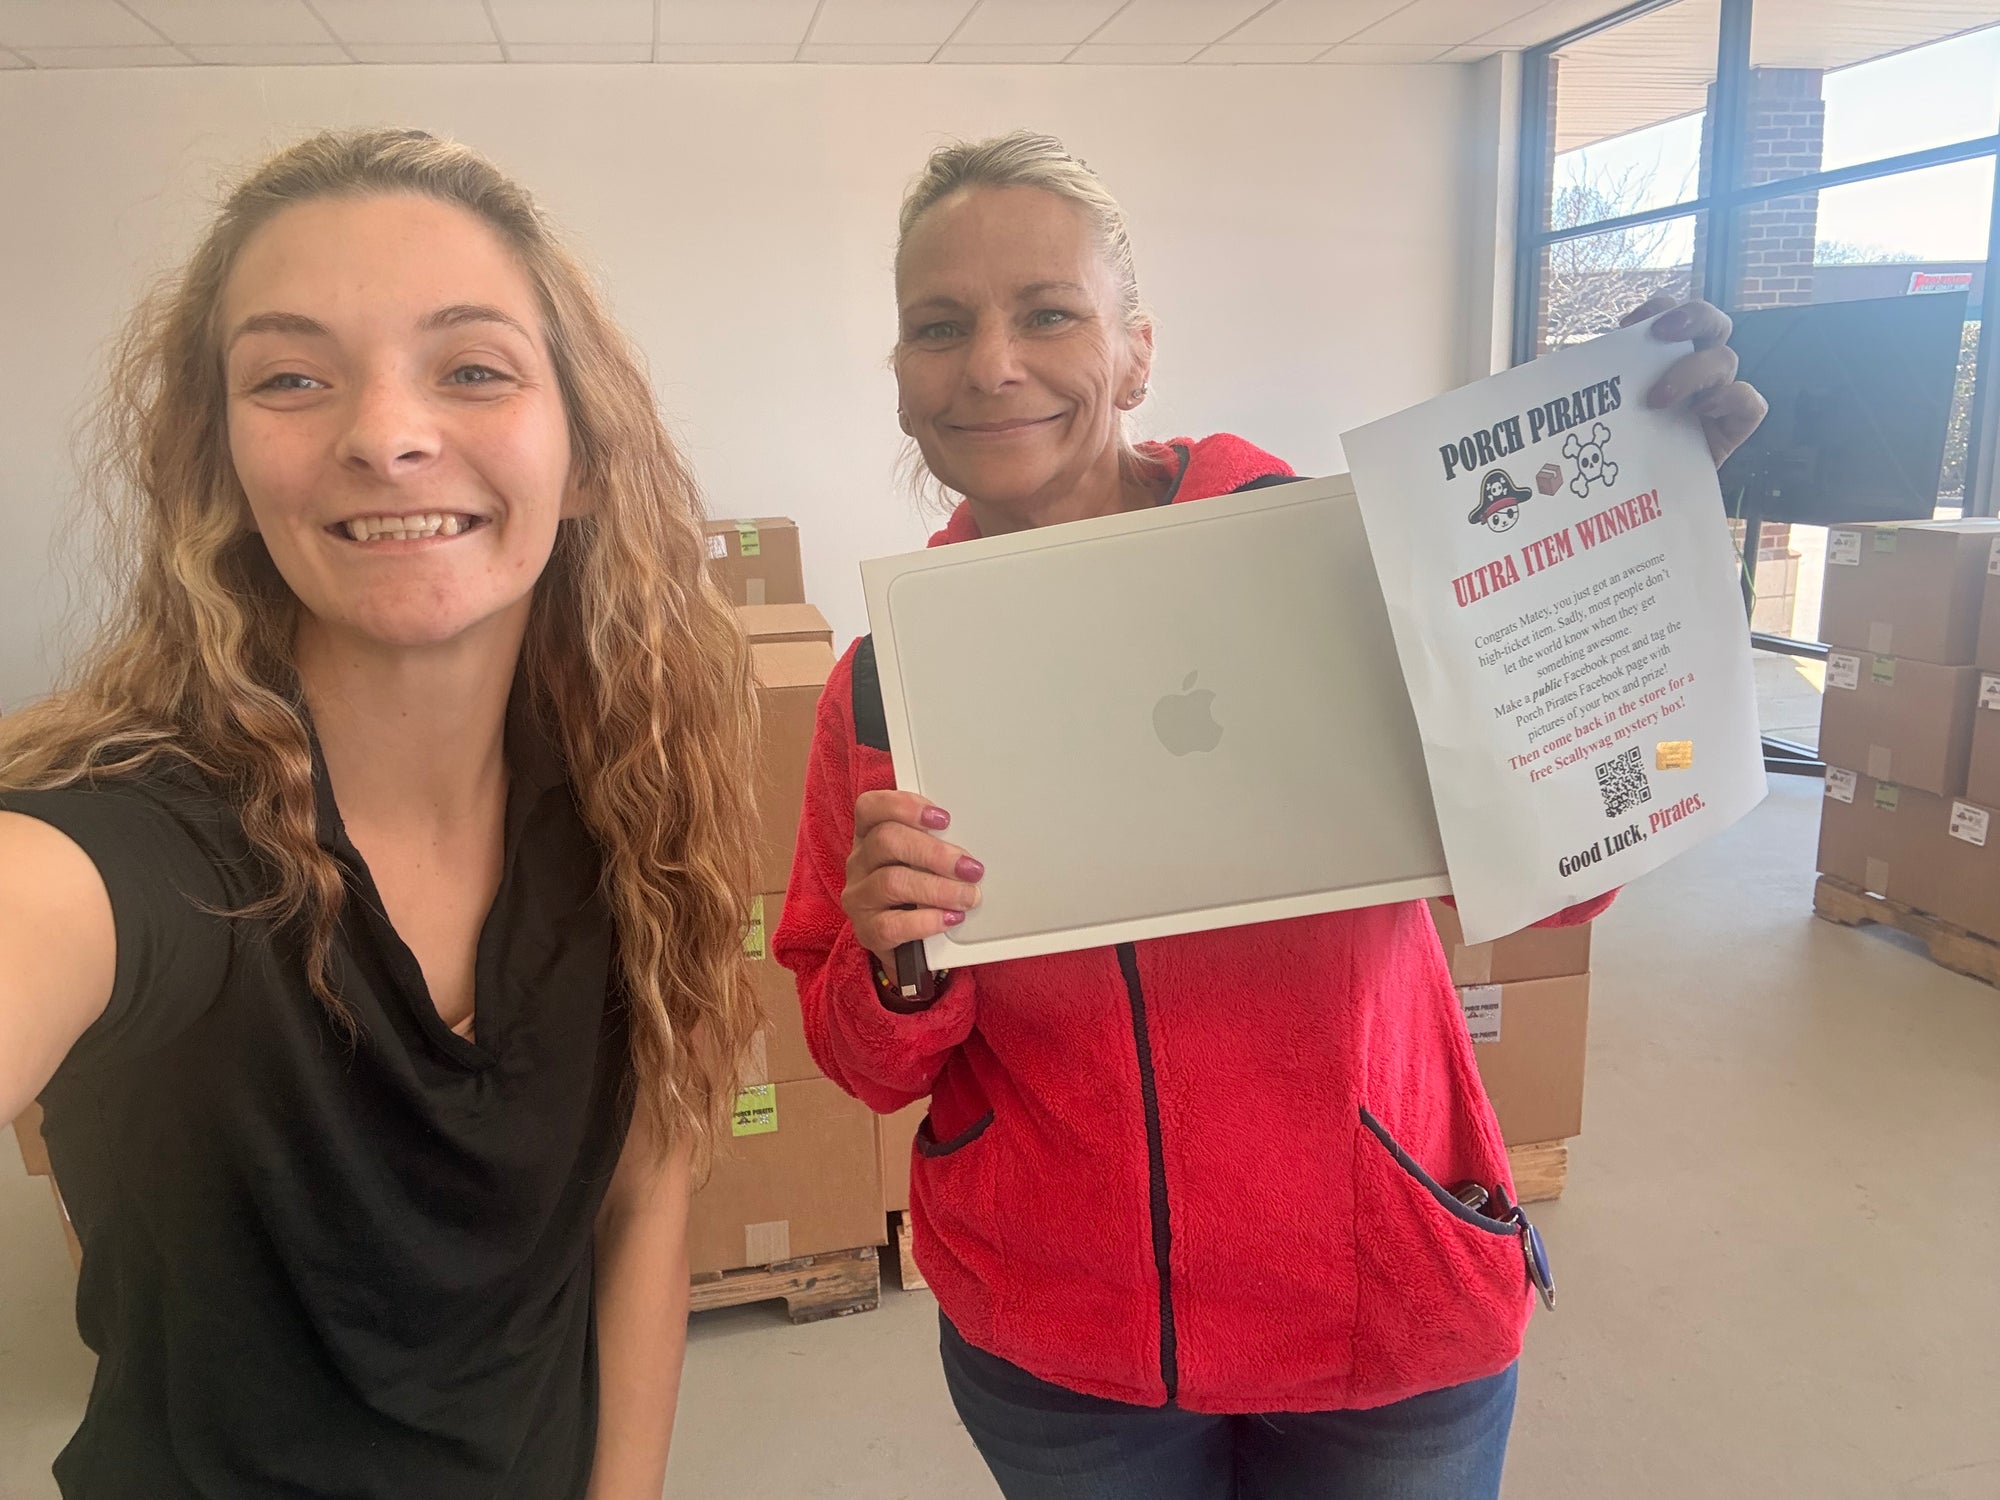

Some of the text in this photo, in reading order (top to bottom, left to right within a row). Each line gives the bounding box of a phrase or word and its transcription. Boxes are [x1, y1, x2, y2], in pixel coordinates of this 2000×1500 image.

[1439, 375, 1622, 481] PORCH PIRATES
[1451, 489, 1662, 608] ULTRA ITEM WINNER!
[1474, 622, 1518, 649] Congrats
[1553, 597, 1572, 615] you
[1573, 587, 1591, 606] just
[1592, 579, 1608, 596] got
[1609, 573, 1621, 585] an
[1622, 553, 1665, 579] awesome
[1478, 635, 1531, 667] high-ticket
[1532, 625, 1556, 642] item.
[1557, 610, 1587, 629] Sadly,
[1588, 596, 1611, 615] most
[1612, 581, 1644, 606] people
[1503, 595, 1656, 675] let the world know when they get
[1493, 621, 1682, 719] Make a public Facebook post and tag the
[1515, 643, 1671, 727] Porch Pirates Facebook page with
[1537, 626, 1632, 678] something awesome.
[1508, 672, 1695, 771] Then come back in the store for a
[1527, 663, 1668, 744] pictures of your box and prize!
[1529, 695, 1686, 783] free Scallywag mystery box!
[1558, 793, 1706, 878] Good Luck, Pirates.
